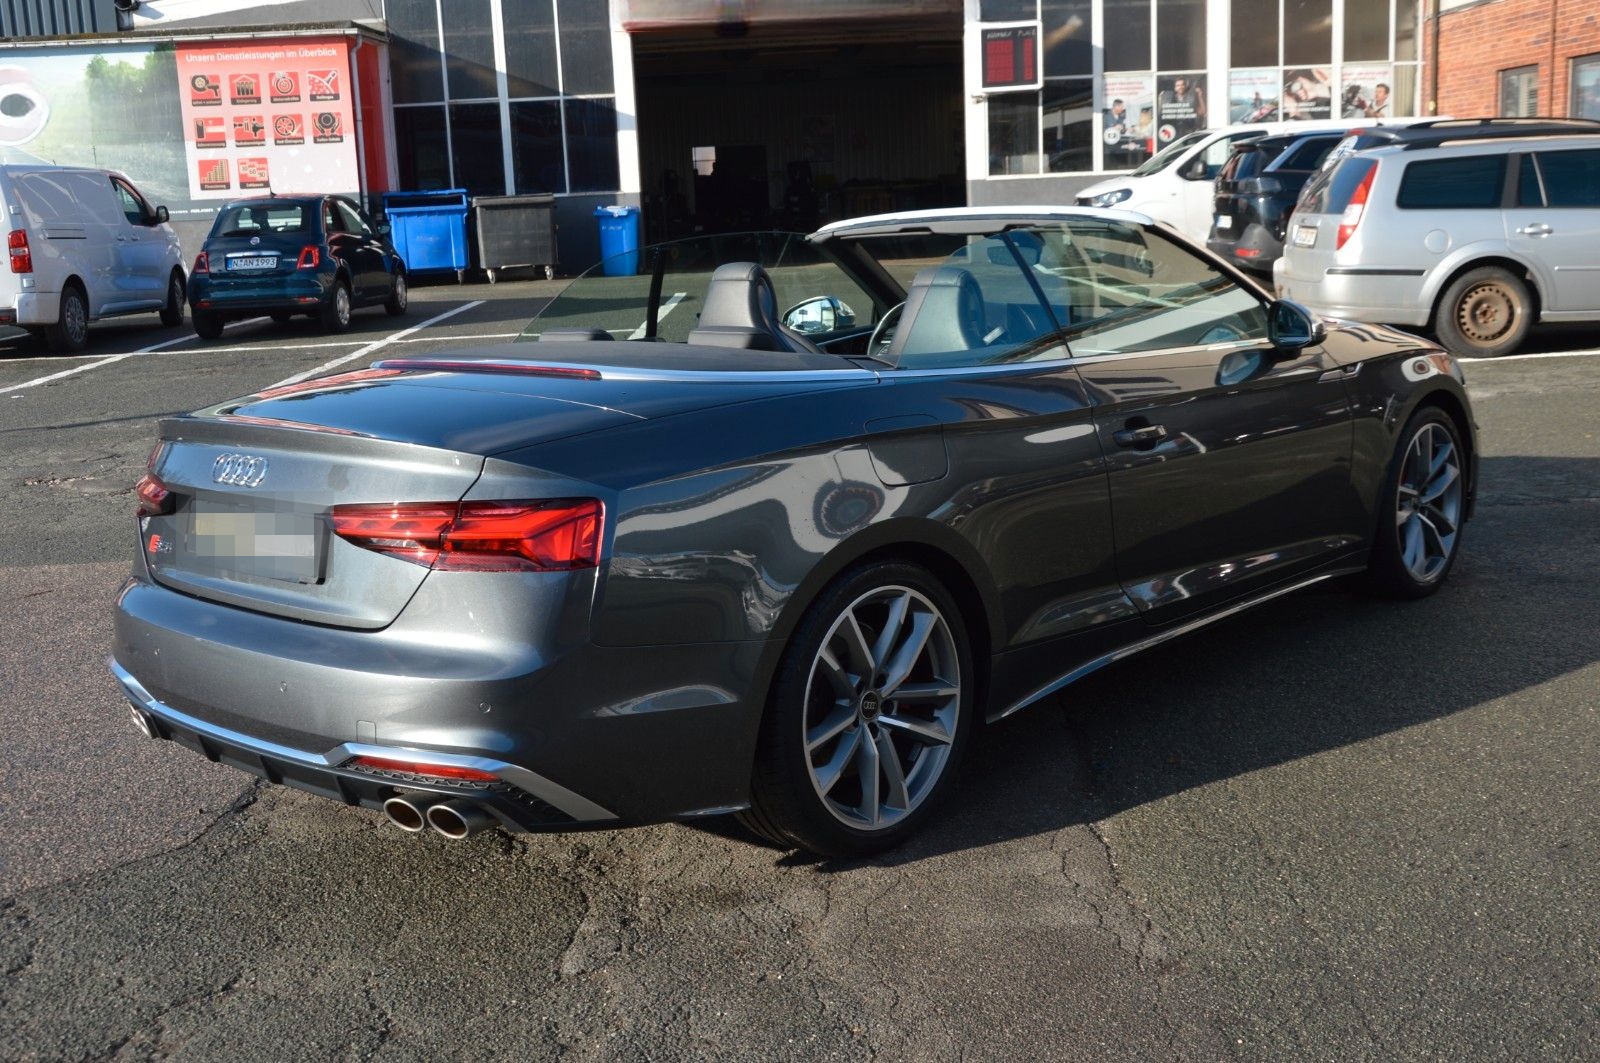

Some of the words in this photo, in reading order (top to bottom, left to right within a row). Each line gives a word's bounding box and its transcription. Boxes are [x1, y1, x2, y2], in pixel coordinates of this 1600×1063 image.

[185, 53, 215, 63] Unsere
[216, 50, 285, 62] Dienstleistungen
[286, 49, 297, 57] im
[298, 47, 337, 57] Überblick
